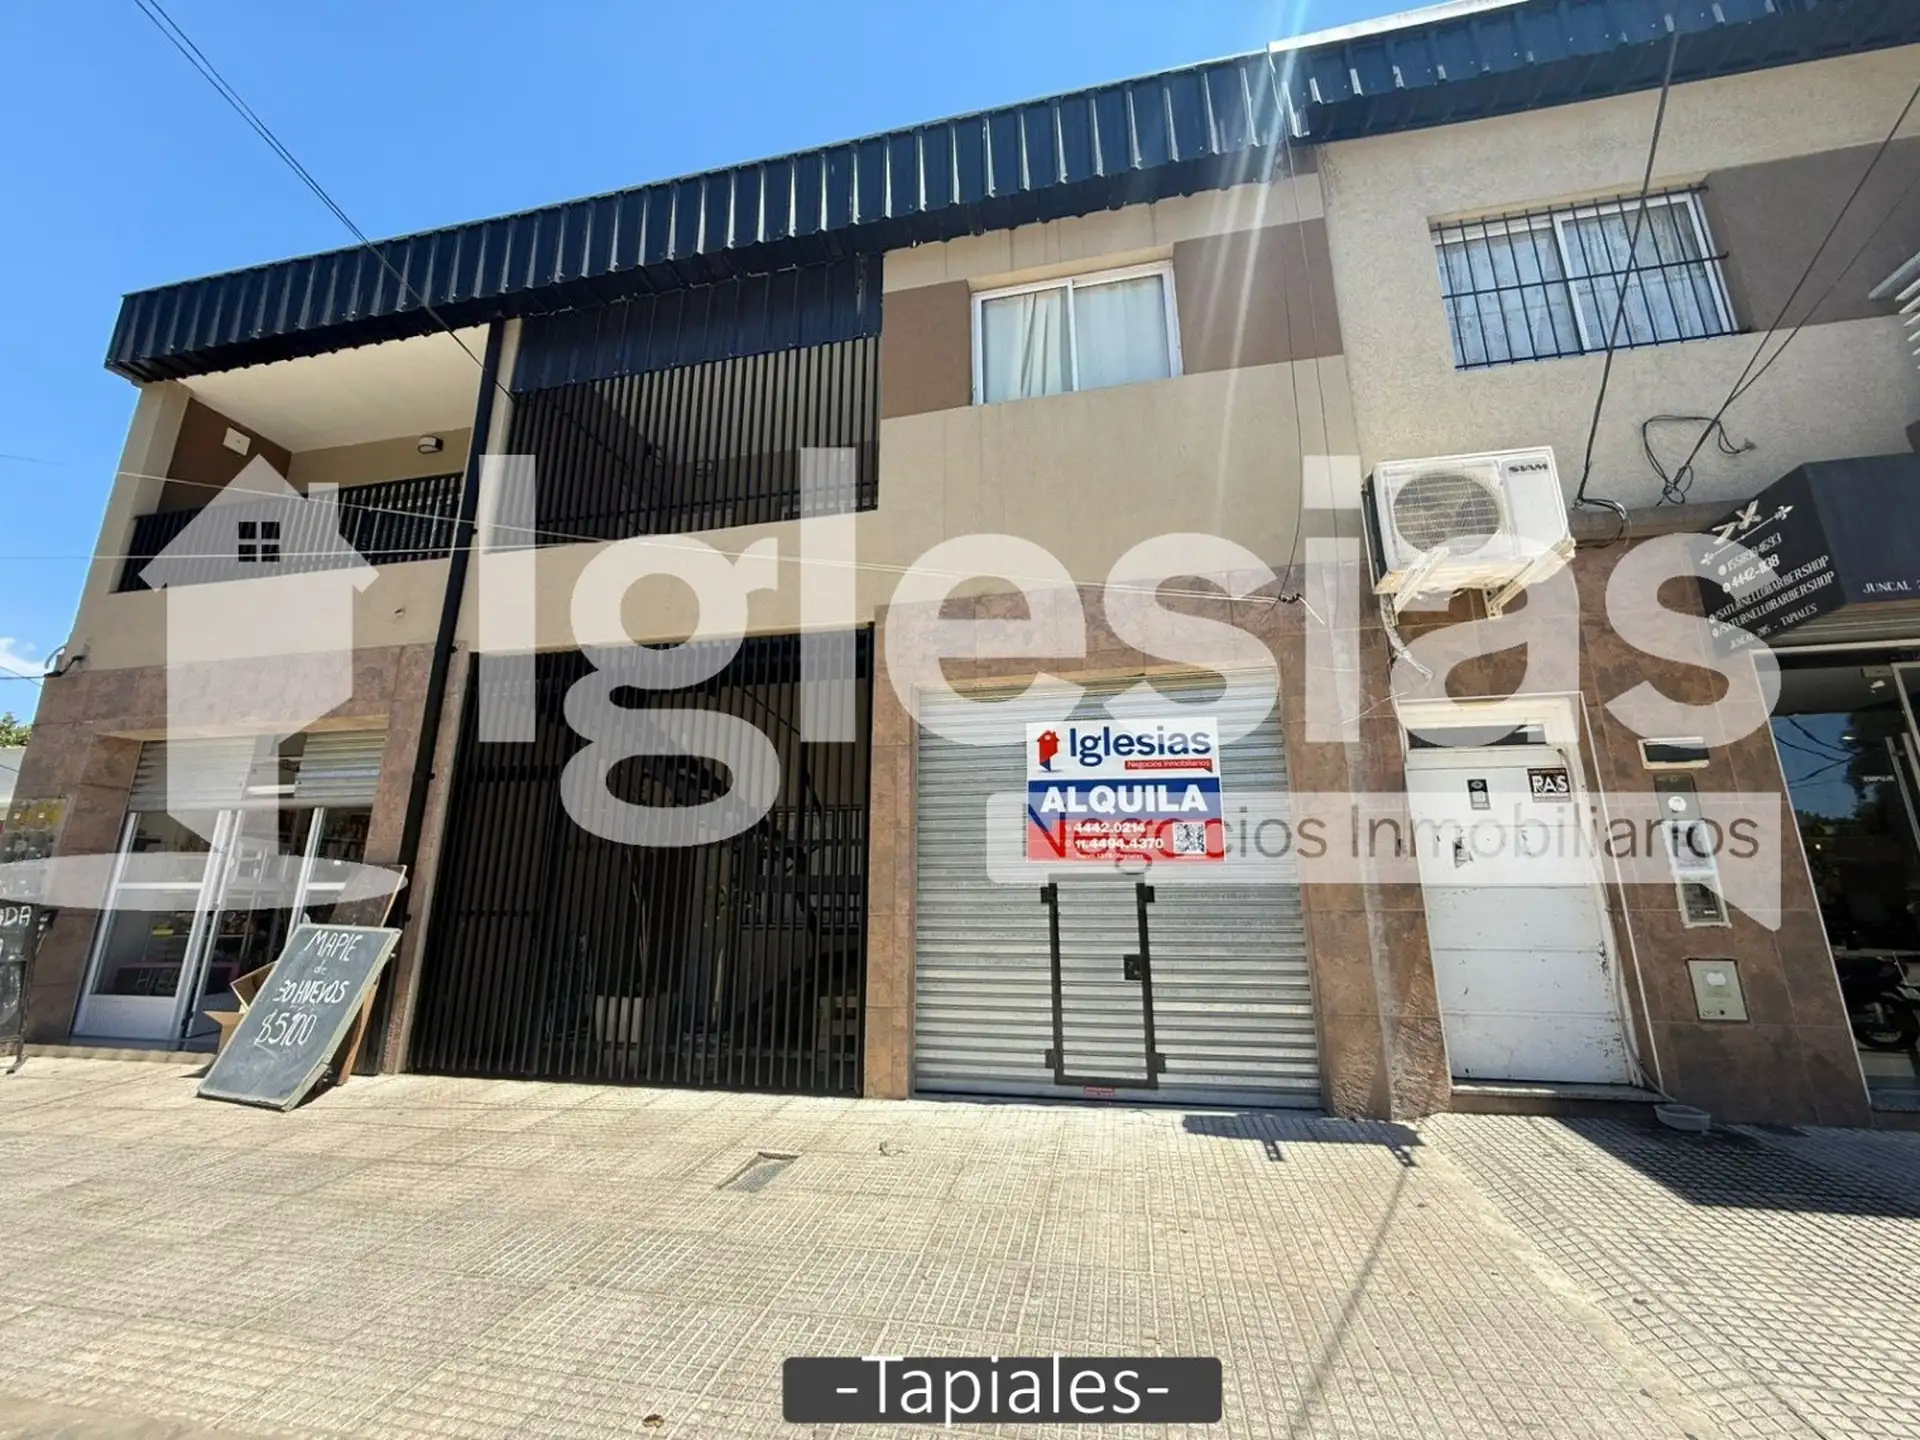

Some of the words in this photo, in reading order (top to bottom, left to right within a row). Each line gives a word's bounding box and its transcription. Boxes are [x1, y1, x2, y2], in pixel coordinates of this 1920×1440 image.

[1862, 580, 1912, 593] JUNCAL
[1070, 725, 1211, 767] Iglesias
[1531, 775, 1568, 793] RAS
[1040, 784, 1208, 815] ALQUILA
